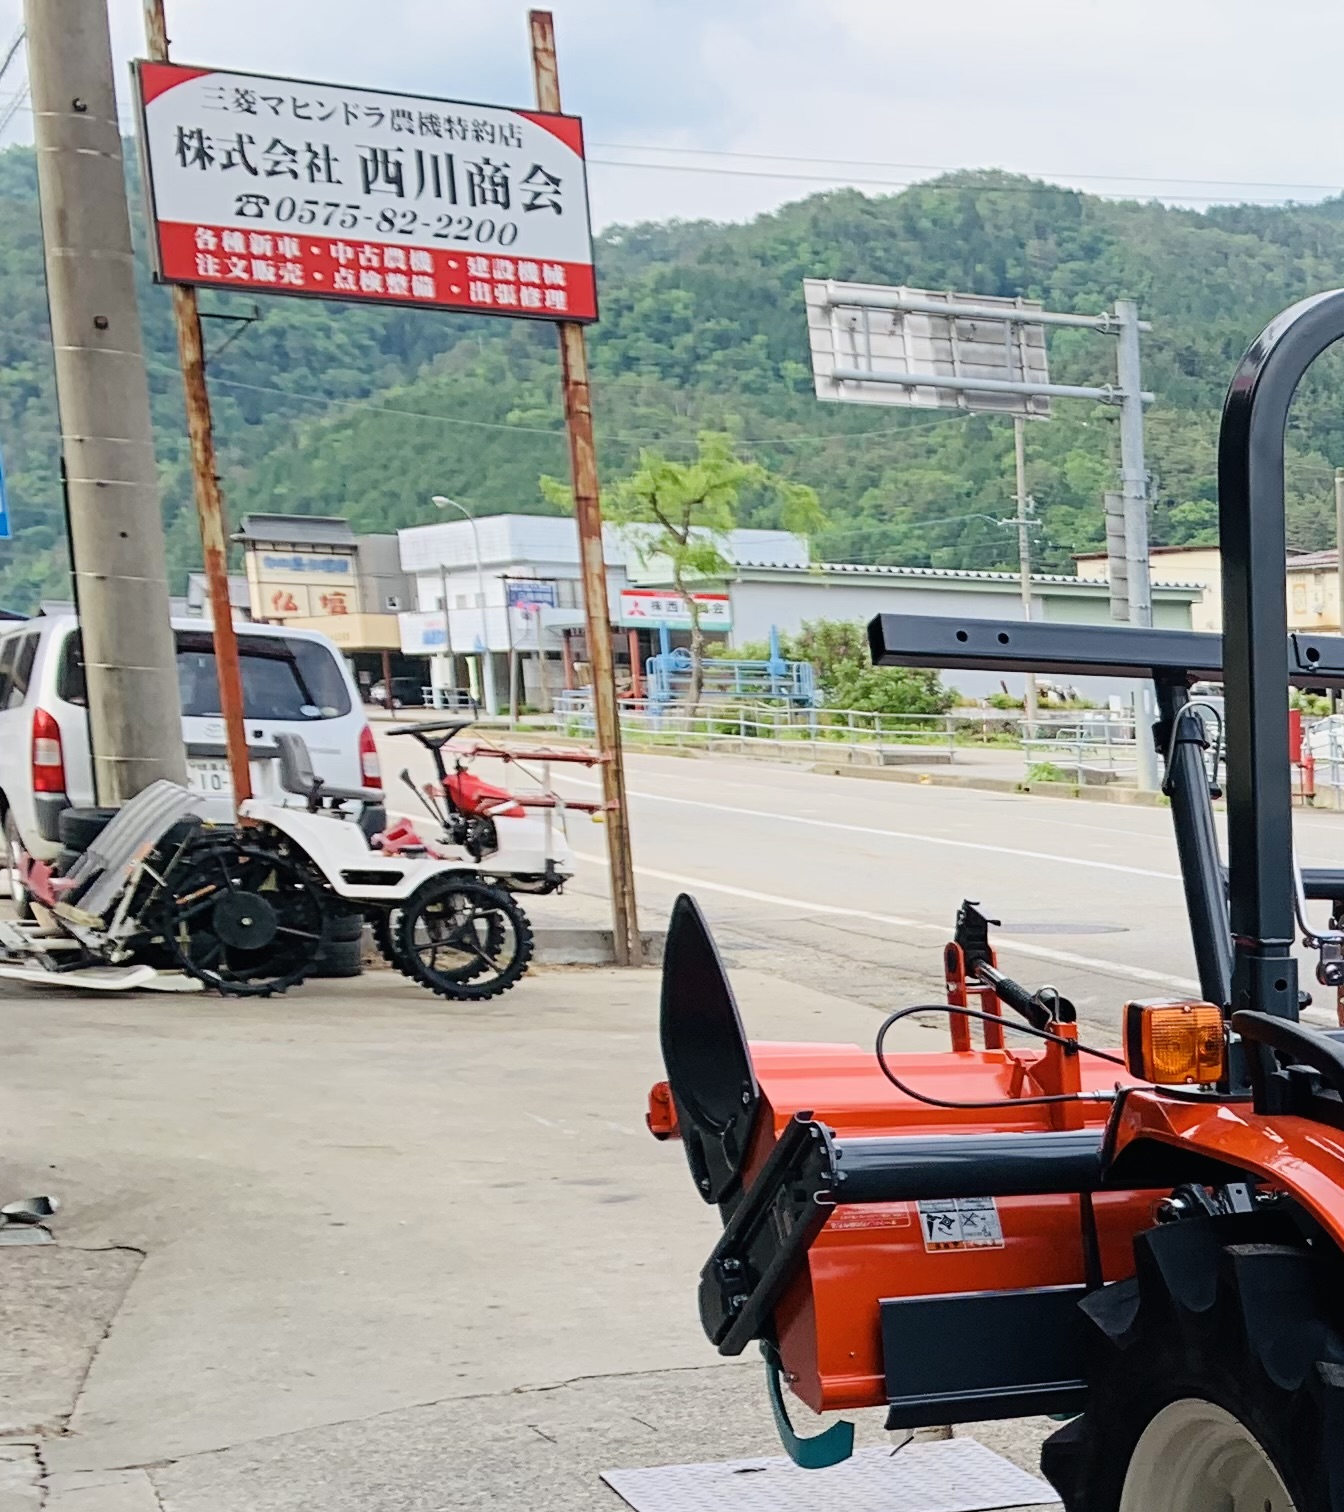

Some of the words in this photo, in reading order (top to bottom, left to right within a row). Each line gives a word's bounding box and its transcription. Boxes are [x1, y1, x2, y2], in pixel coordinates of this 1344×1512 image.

[201, 85, 523, 149] 三菱マヒンドラ農機特約店
[174, 125, 343, 186] 株式会社
[354, 142, 565, 217] 西川商会
[275, 195, 518, 247] 0575-82-2200
